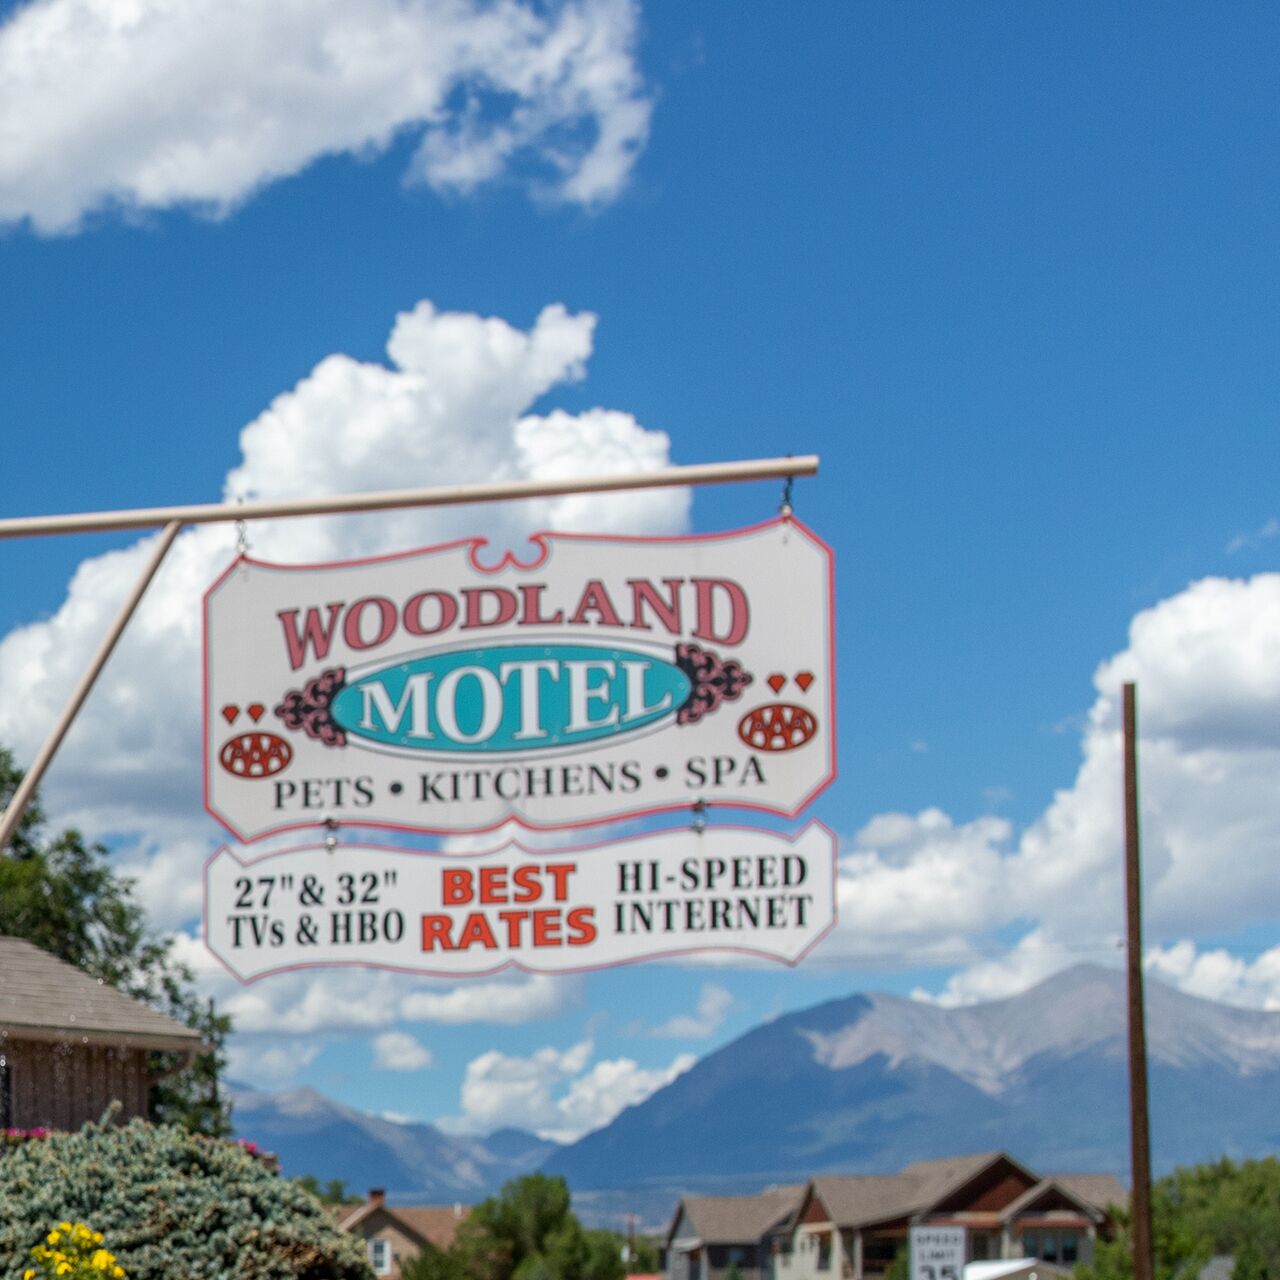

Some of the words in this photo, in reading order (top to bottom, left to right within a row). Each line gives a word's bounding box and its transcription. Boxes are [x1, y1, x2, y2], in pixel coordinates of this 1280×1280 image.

[276, 577, 750, 671] WOODLAND
[358, 659, 673, 744] MOTEL
[274, 777, 374, 810] PETS
[418, 761, 641, 803] KITCHENS
[684, 755, 768, 788] SPA
[337, 870, 397, 904] 32"
[442, 863, 576, 905] BEST
[617, 854, 808, 893] HI-SPEED
[227, 914, 285, 948] TVs
[296, 913, 319, 945] &
[330, 909, 404, 945] HBO
[421, 907, 597, 952] RATES
[614, 894, 813, 934] INTERNET
